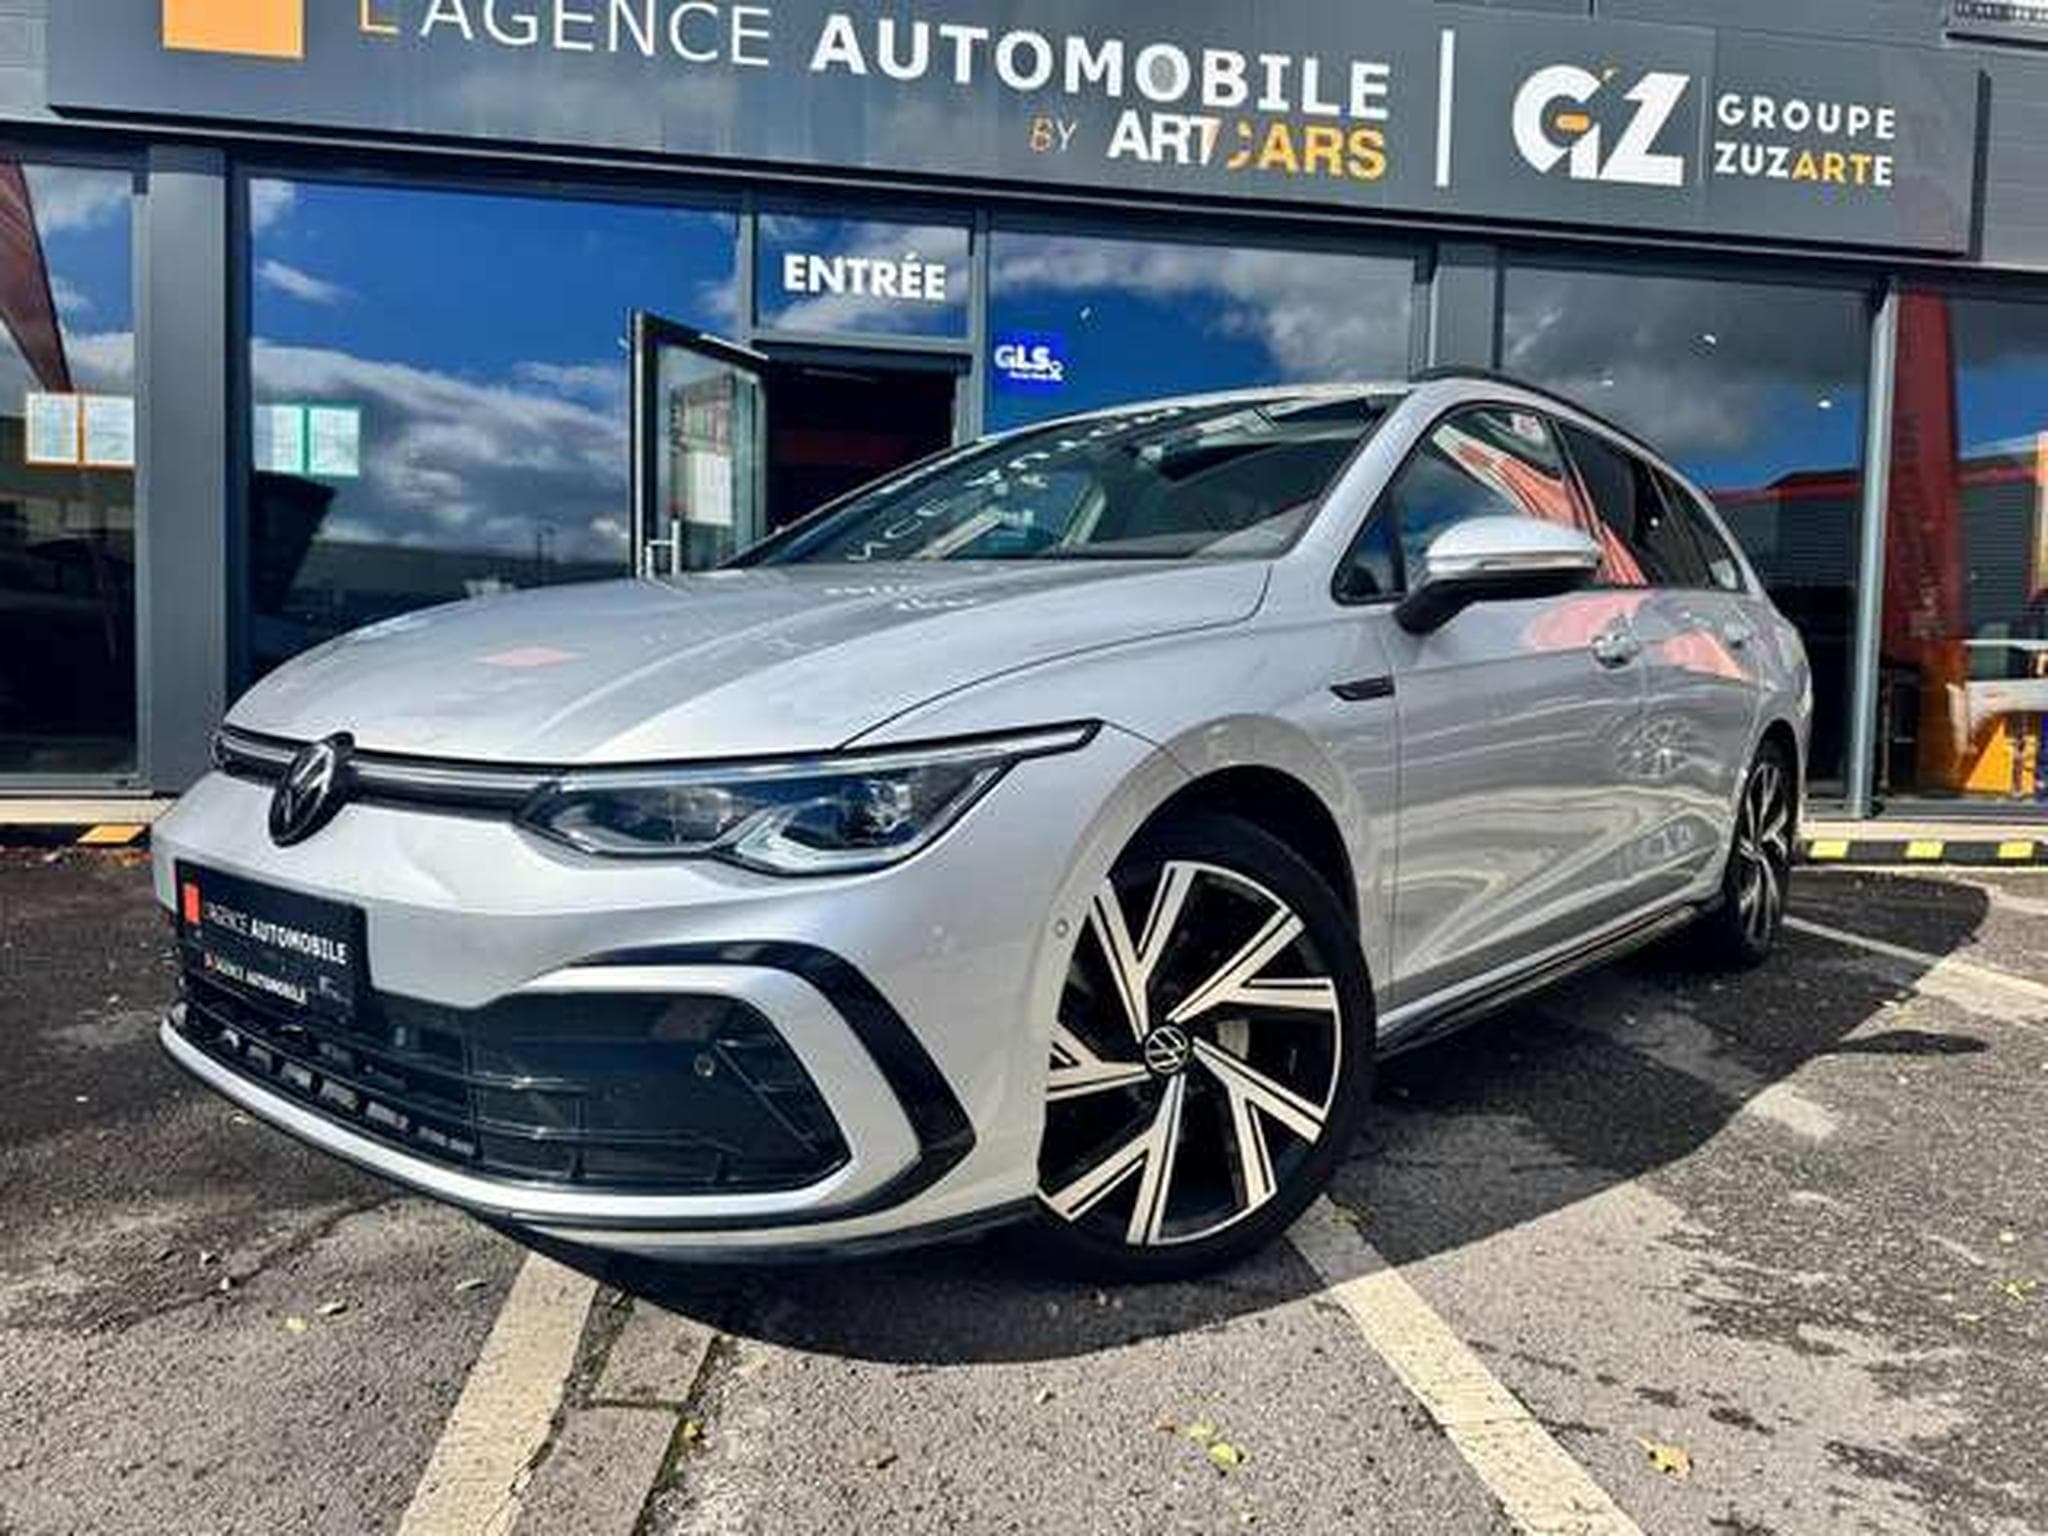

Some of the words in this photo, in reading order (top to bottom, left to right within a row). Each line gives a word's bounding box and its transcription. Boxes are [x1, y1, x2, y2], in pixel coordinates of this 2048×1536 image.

[810, 12, 1391, 120] AUTOMOBILE
[1030, 117, 1077, 153] BY
[1717, 94, 1896, 140] GROUPE
[1714, 141, 1894, 188] ZUZARTE
[783, 253, 946, 300] ENTRÉE
[251, 918, 348, 966] AUTOMOBILE
